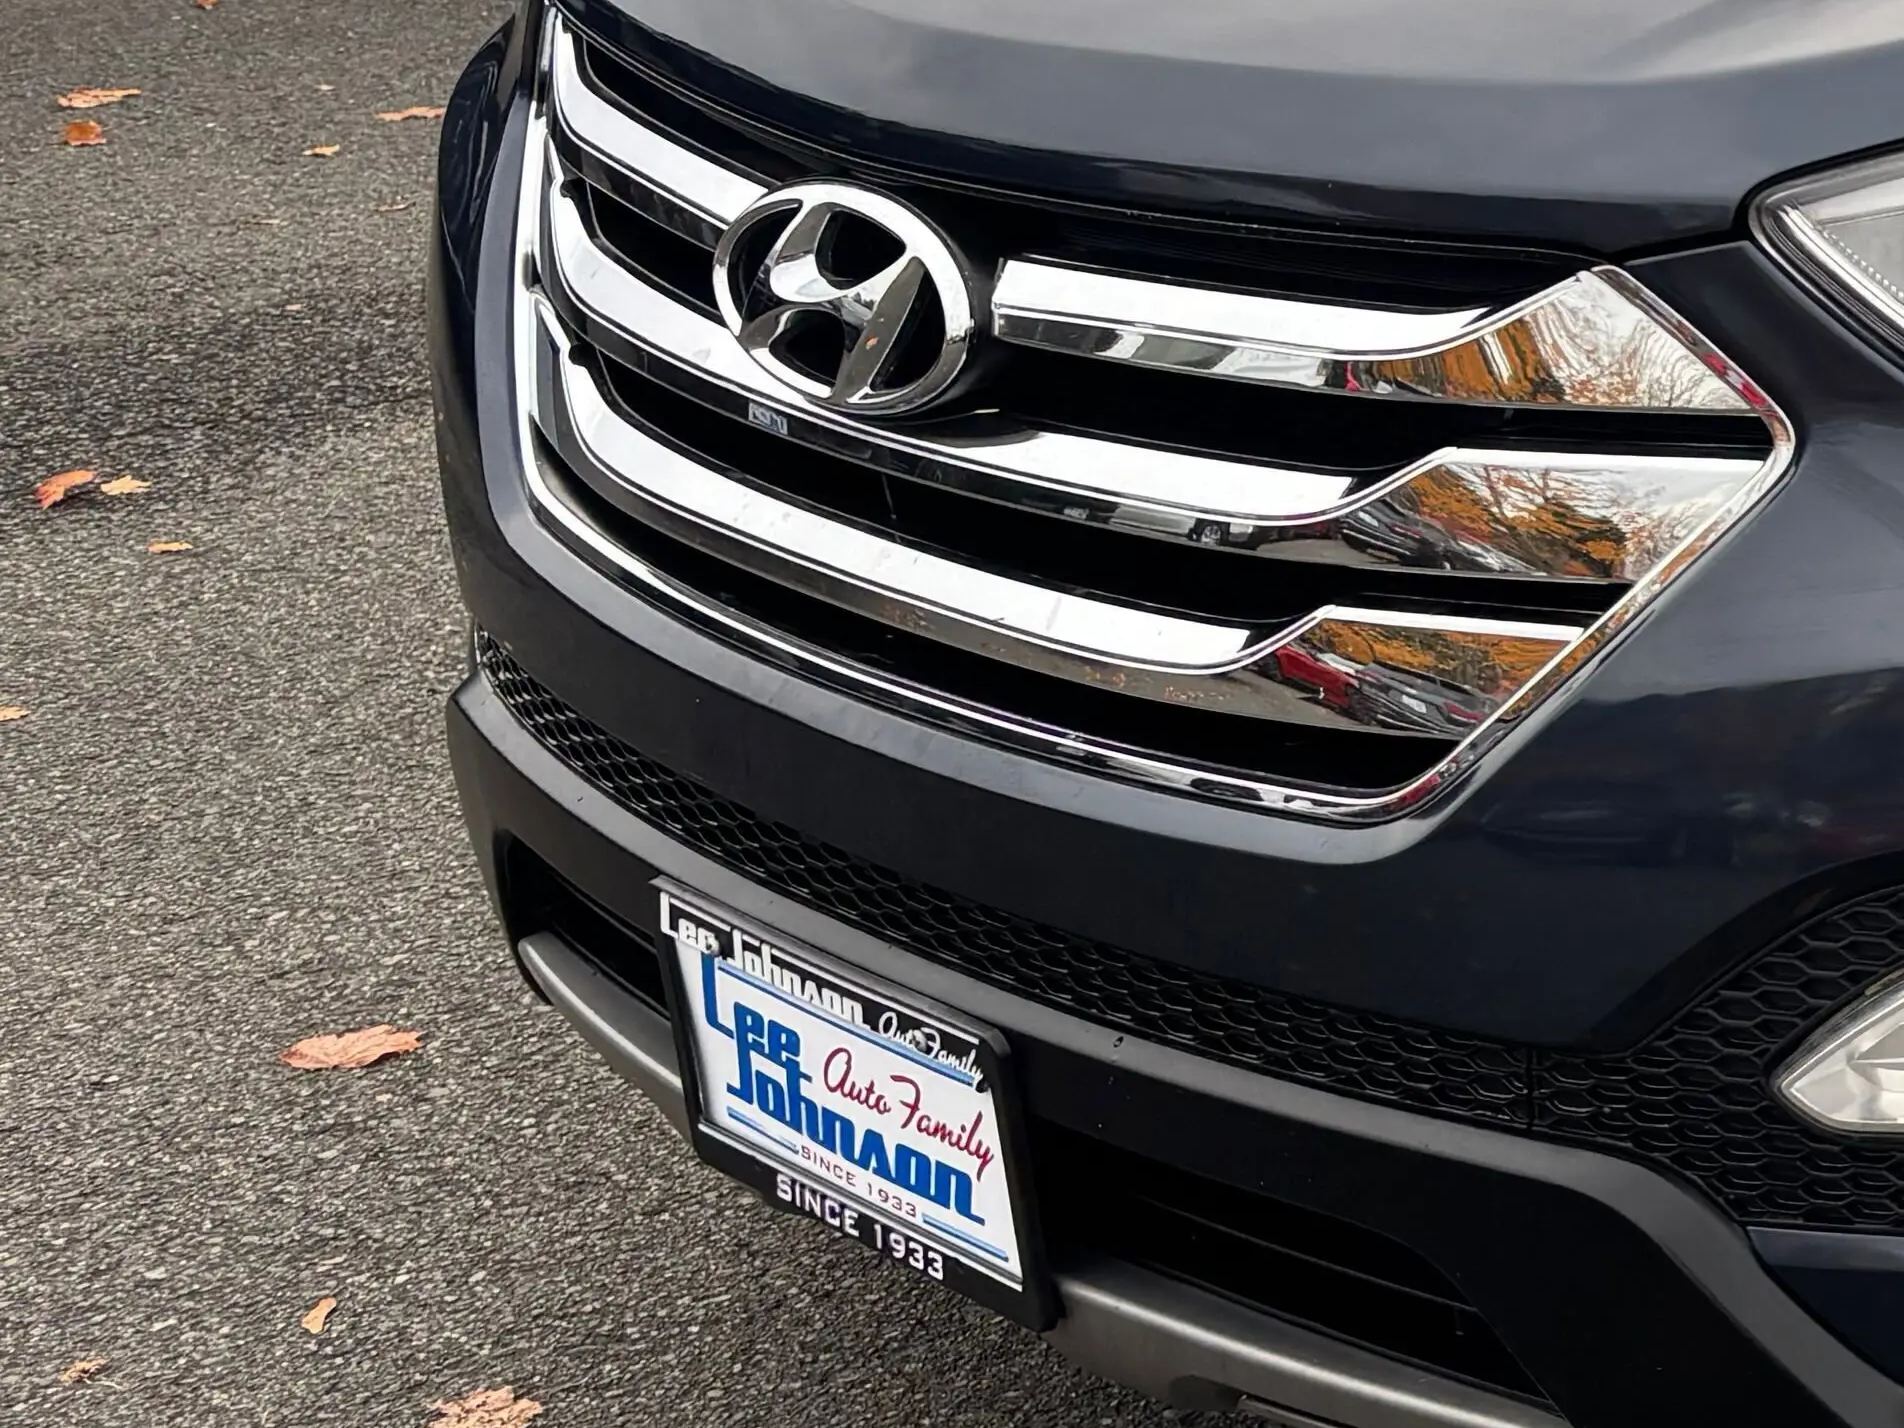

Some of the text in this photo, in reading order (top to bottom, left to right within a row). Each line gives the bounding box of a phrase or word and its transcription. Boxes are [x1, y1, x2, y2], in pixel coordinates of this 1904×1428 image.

[700, 953, 813, 1084] Lee
[725, 928, 872, 1031] Johnson
[726, 1050, 987, 1227] Johnson
[823, 1047, 995, 1183] Auto Family
[776, 1172, 944, 1281] SINCE 1933
[801, 1145, 918, 1219] SINCE 1933
